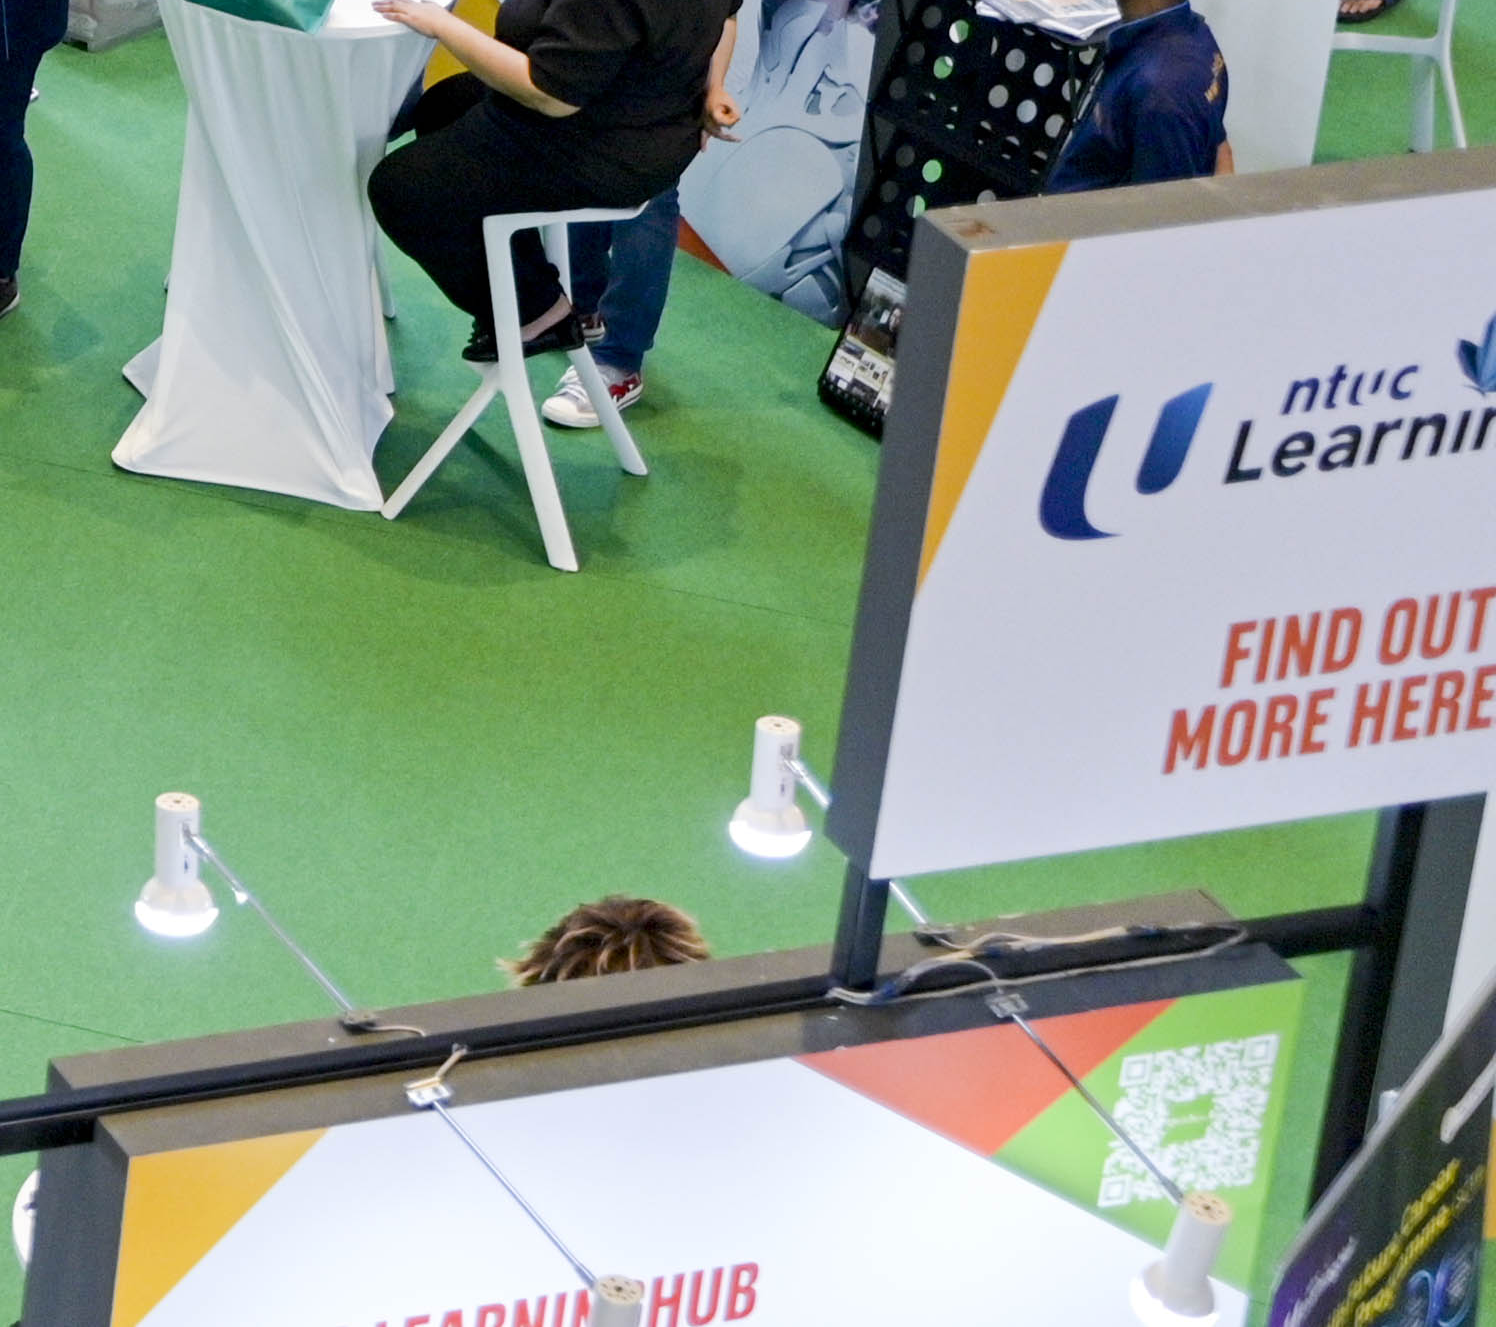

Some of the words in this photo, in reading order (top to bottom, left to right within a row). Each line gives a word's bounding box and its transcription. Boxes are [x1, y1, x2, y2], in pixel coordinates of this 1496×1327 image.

[1218, 607, 1361, 690] FIND
[1380, 587, 1496, 666] OUT
[1162, 687, 1334, 775] MORE
